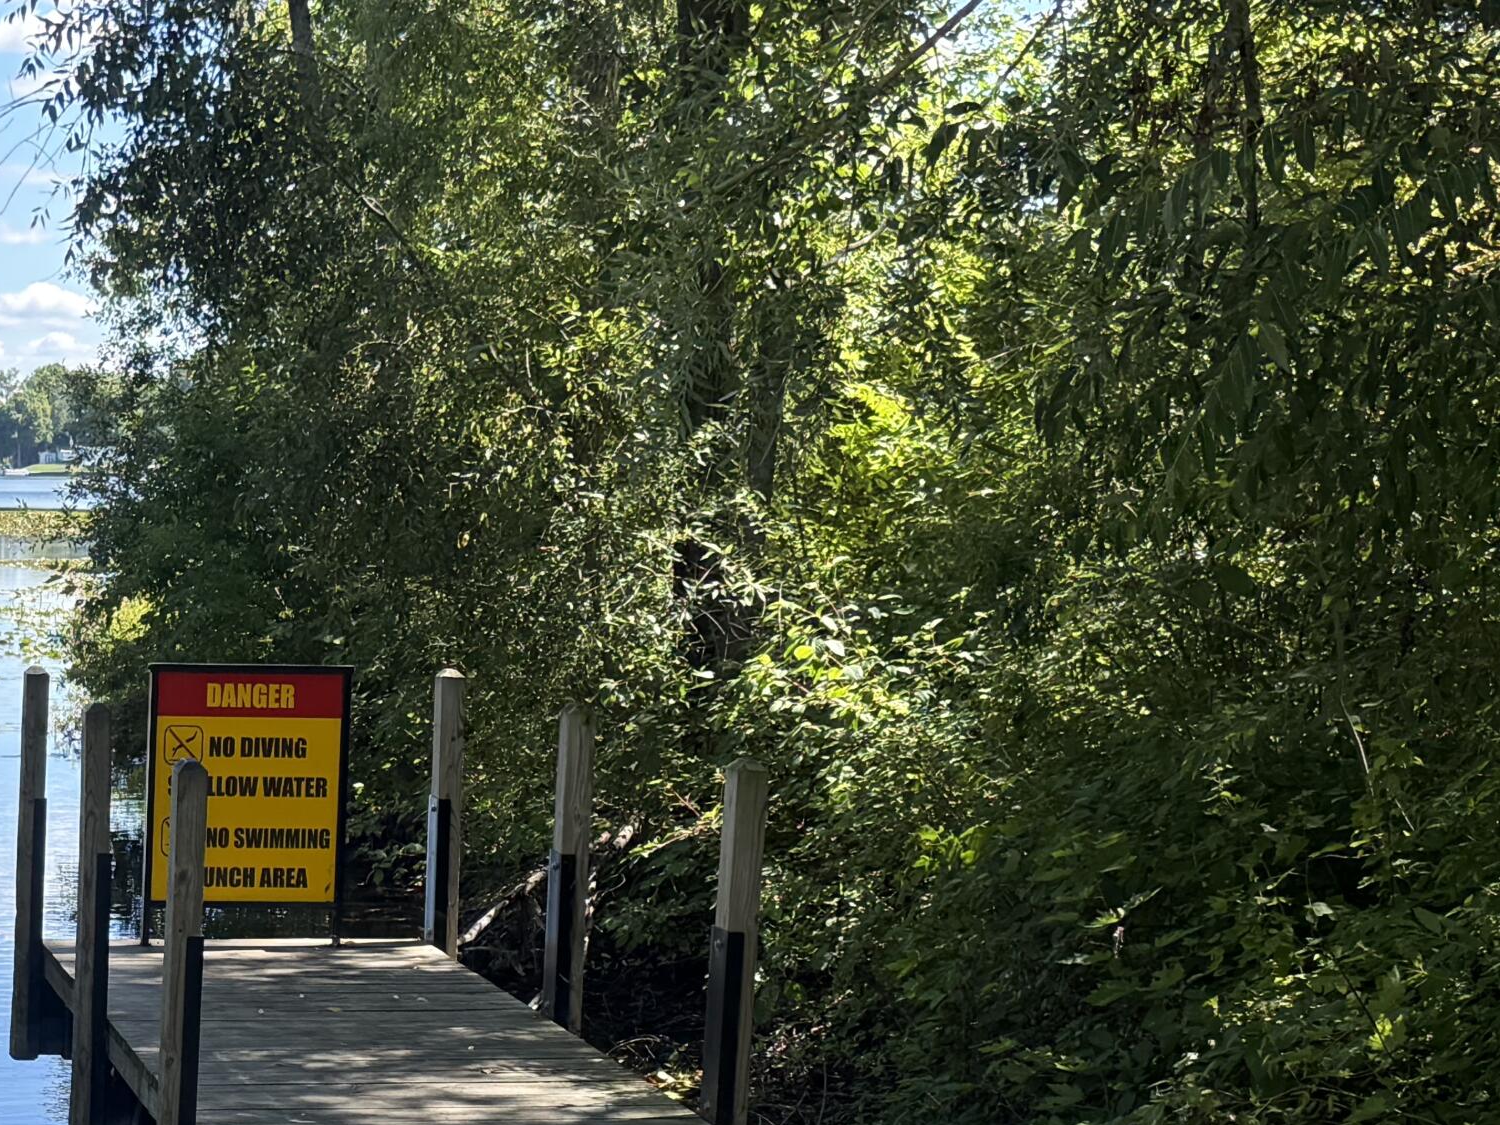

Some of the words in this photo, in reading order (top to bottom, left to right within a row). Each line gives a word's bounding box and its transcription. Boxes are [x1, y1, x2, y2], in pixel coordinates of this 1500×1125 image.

[206, 683, 295, 709] DANGER
[209, 736, 235, 758] NO
[240, 737, 307, 759] DIVING
[262, 776, 327, 798] WATER
[206, 827, 229, 849] NO
[234, 827, 331, 849] SWIMMING
[204, 866, 255, 888] UNCH
[259, 867, 308, 888] AREA
